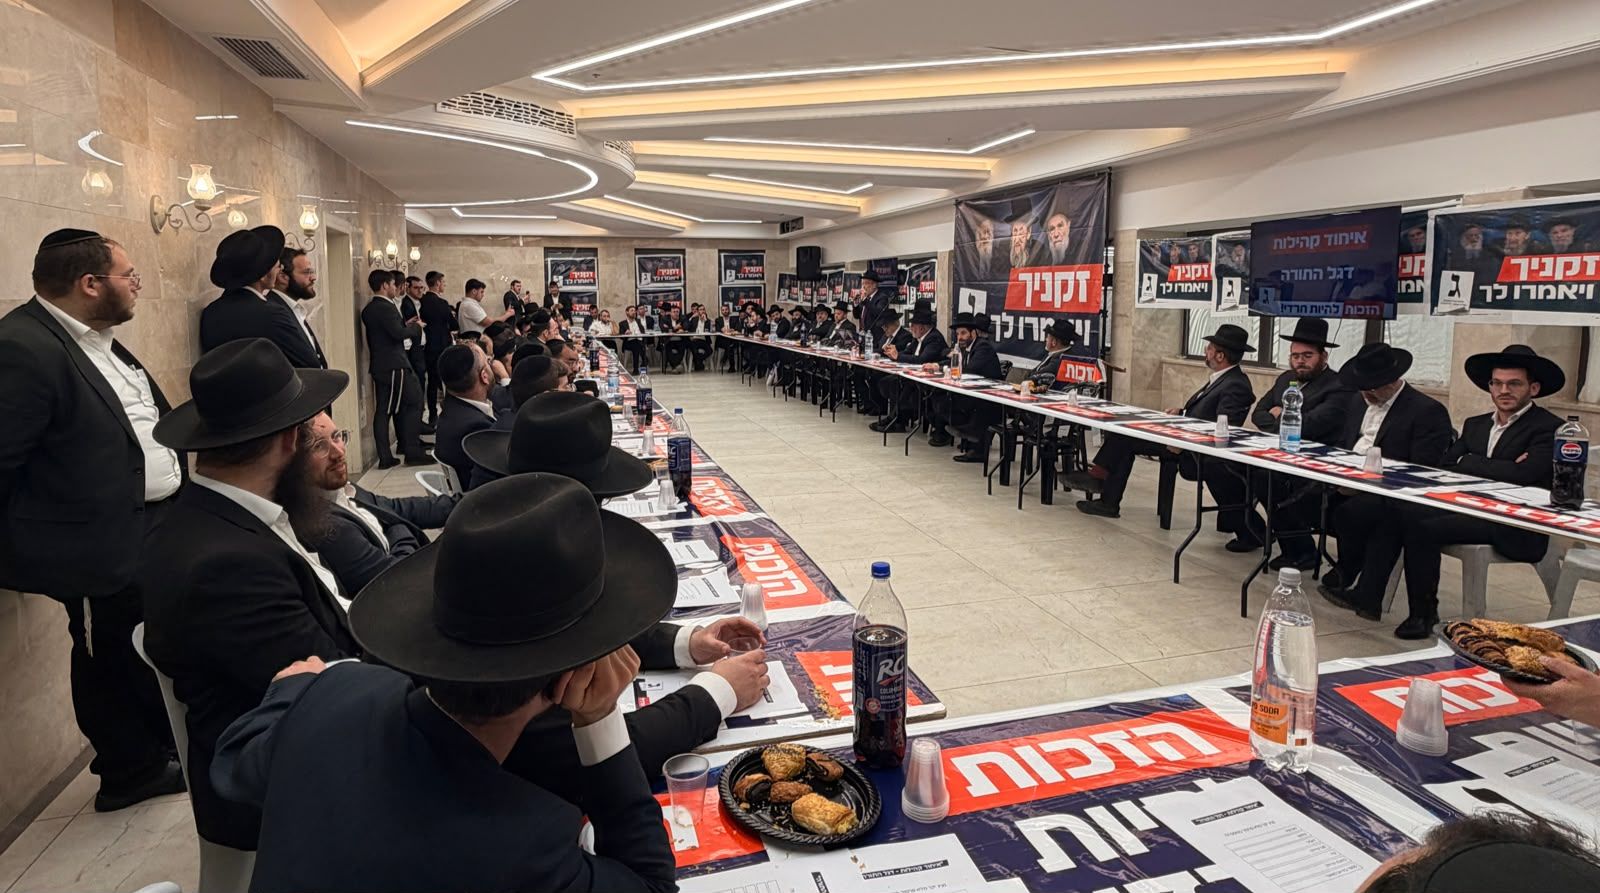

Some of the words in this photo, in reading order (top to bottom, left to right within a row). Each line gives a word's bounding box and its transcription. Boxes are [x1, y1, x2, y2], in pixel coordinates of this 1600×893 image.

[1273, 234, 1320, 250] קהילות
[1324, 230, 1368, 246] איחוד
[1174, 264, 1209, 280] זקניך
[1280, 269, 1324, 281] התורה
[1328, 266, 1355, 280] דגל
[1510, 255, 1600, 281] זקניך
[1018, 270, 1092, 308] זקניך
[1160, 282, 1173, 294] לך
[1174, 282, 1209, 293] ויאמרו
[1447, 273, 1461, 298] ג
[1479, 282, 1508, 302] לך
[1513, 283, 1595, 300] ויאמרו
[1280, 304, 1308, 314] חרדי!
[1309, 302, 1340, 314] להיות
[1345, 303, 1380, 315] הזכות
[990, 312, 1014, 342] לך
[1018, 316, 1091, 346] וימרו
[1065, 364, 1094, 383] זכות
[734, 543, 808, 598] הזכות
[876, 654, 904, 682] RC
[1260, 704, 1280, 715] SODA
[950, 722, 1222, 798] הזכות
[1015, 798, 1162, 873] יות
